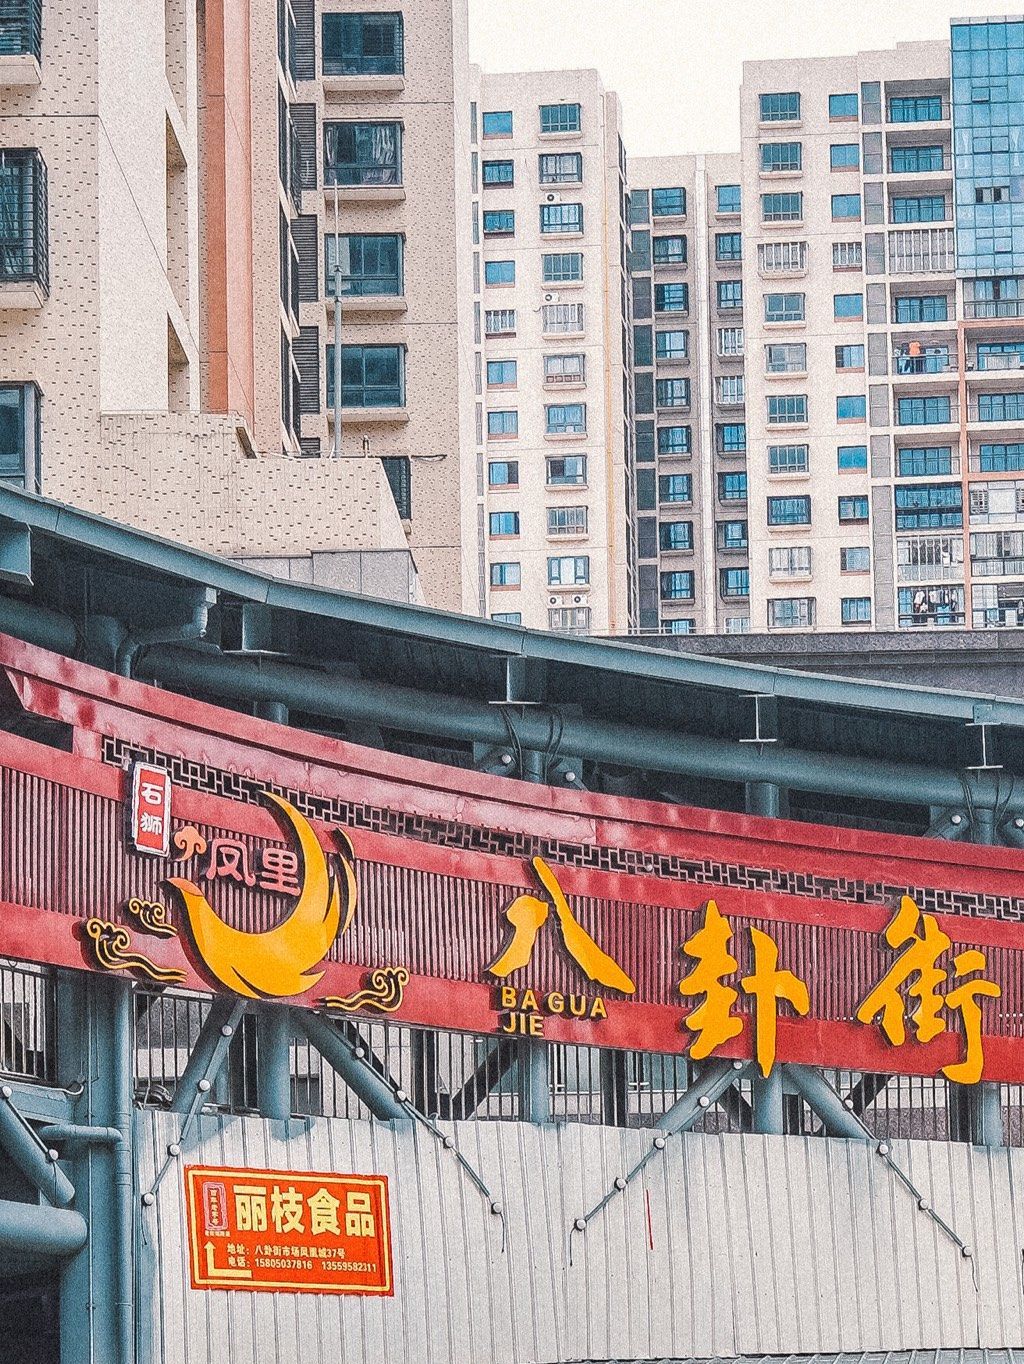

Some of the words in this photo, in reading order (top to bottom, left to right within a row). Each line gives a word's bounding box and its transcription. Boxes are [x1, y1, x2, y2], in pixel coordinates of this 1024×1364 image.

[140, 780, 165, 835] 石狮
[206, 837, 301, 896] 凤里
[488, 856, 1001, 1084] 八卦街
[501, 986, 540, 1012] BA
[548, 992, 608, 1020] GUA
[502, 1012, 545, 1037] JIE
[233, 1184, 376, 1238] 丽枝食品
